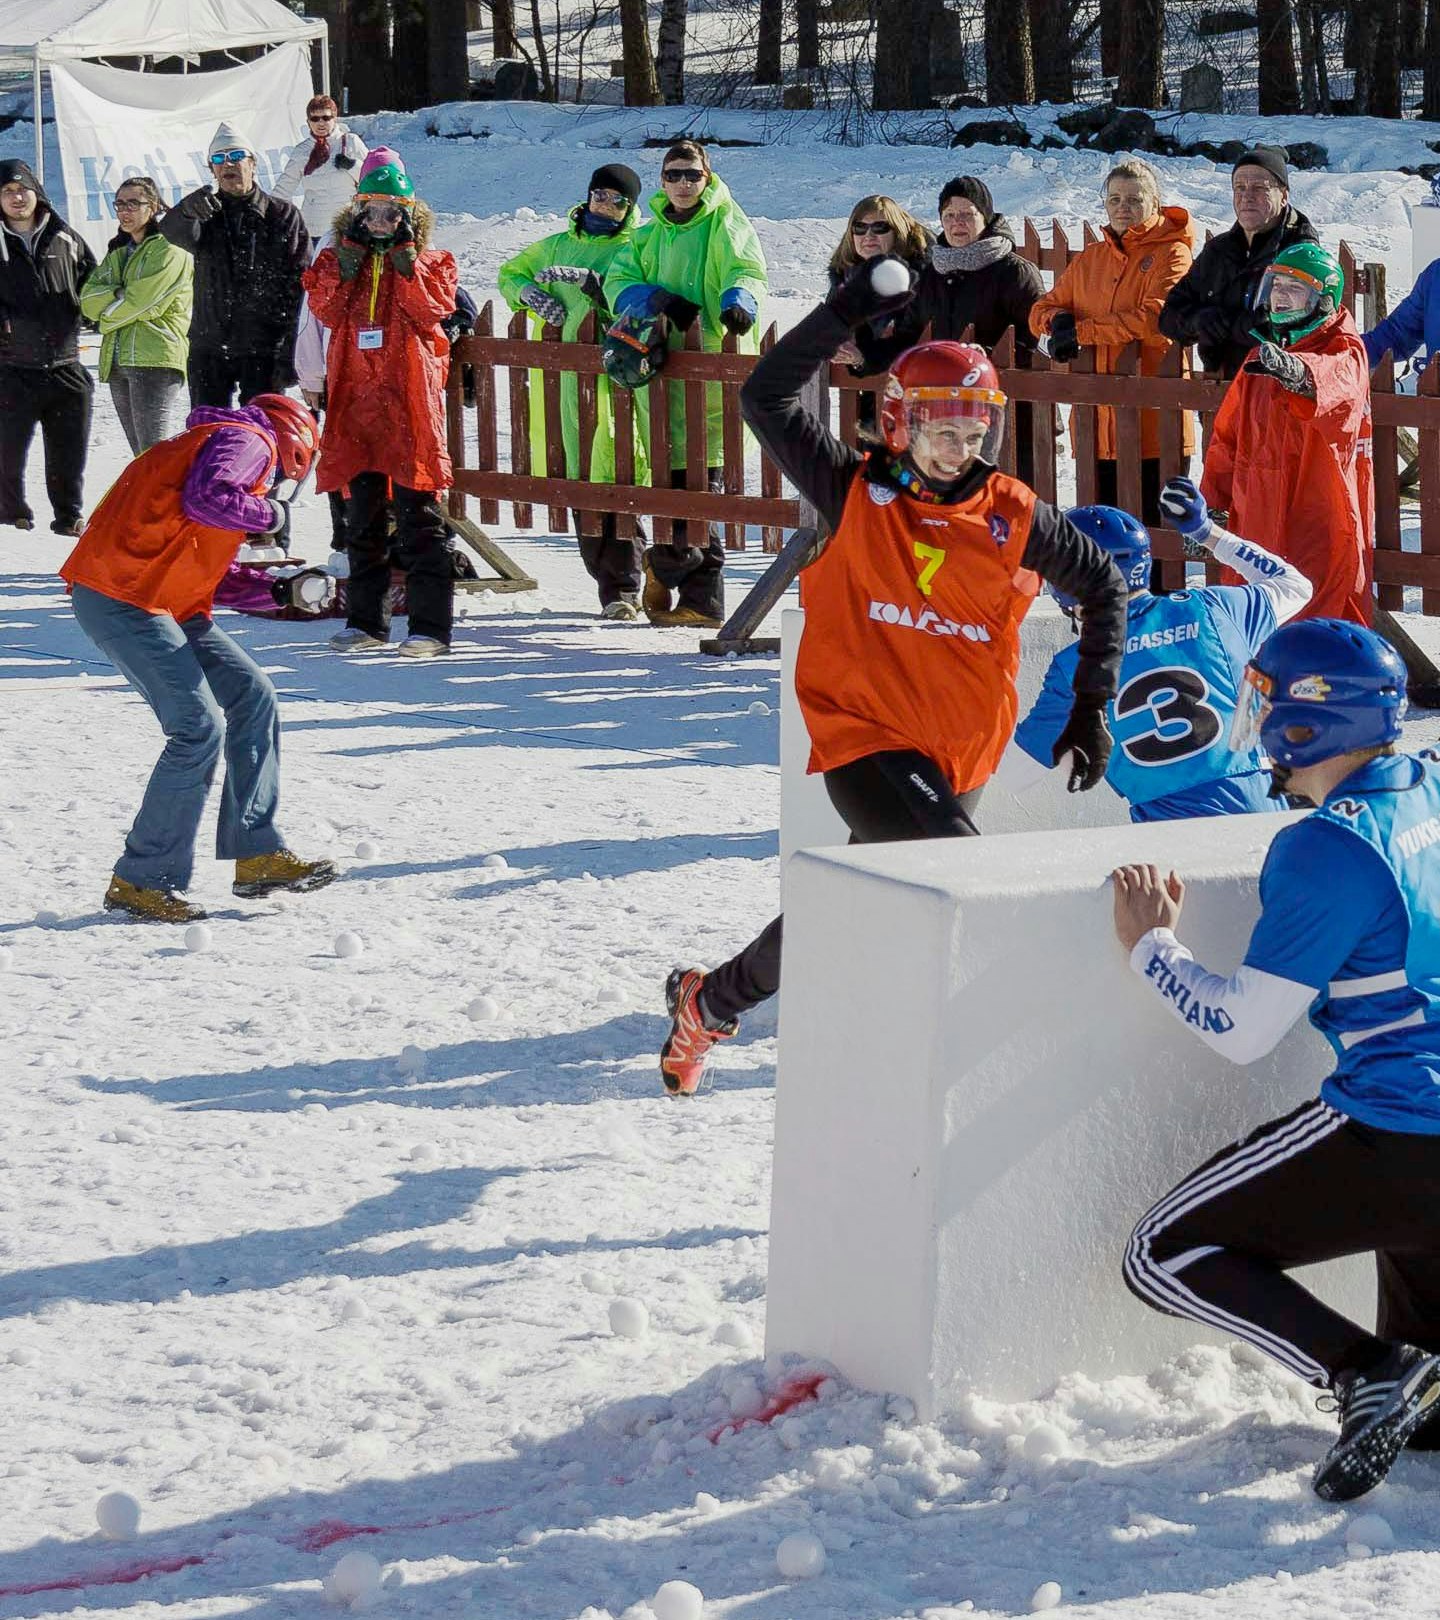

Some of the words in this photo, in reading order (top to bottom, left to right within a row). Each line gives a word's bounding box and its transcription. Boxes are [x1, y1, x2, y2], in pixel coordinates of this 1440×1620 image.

[913, 541, 946, 596] 7
[1114, 665, 1223, 767] 3
[1329, 798, 1367, 819] 2
[1144, 953, 1235, 1034] FINLAND
